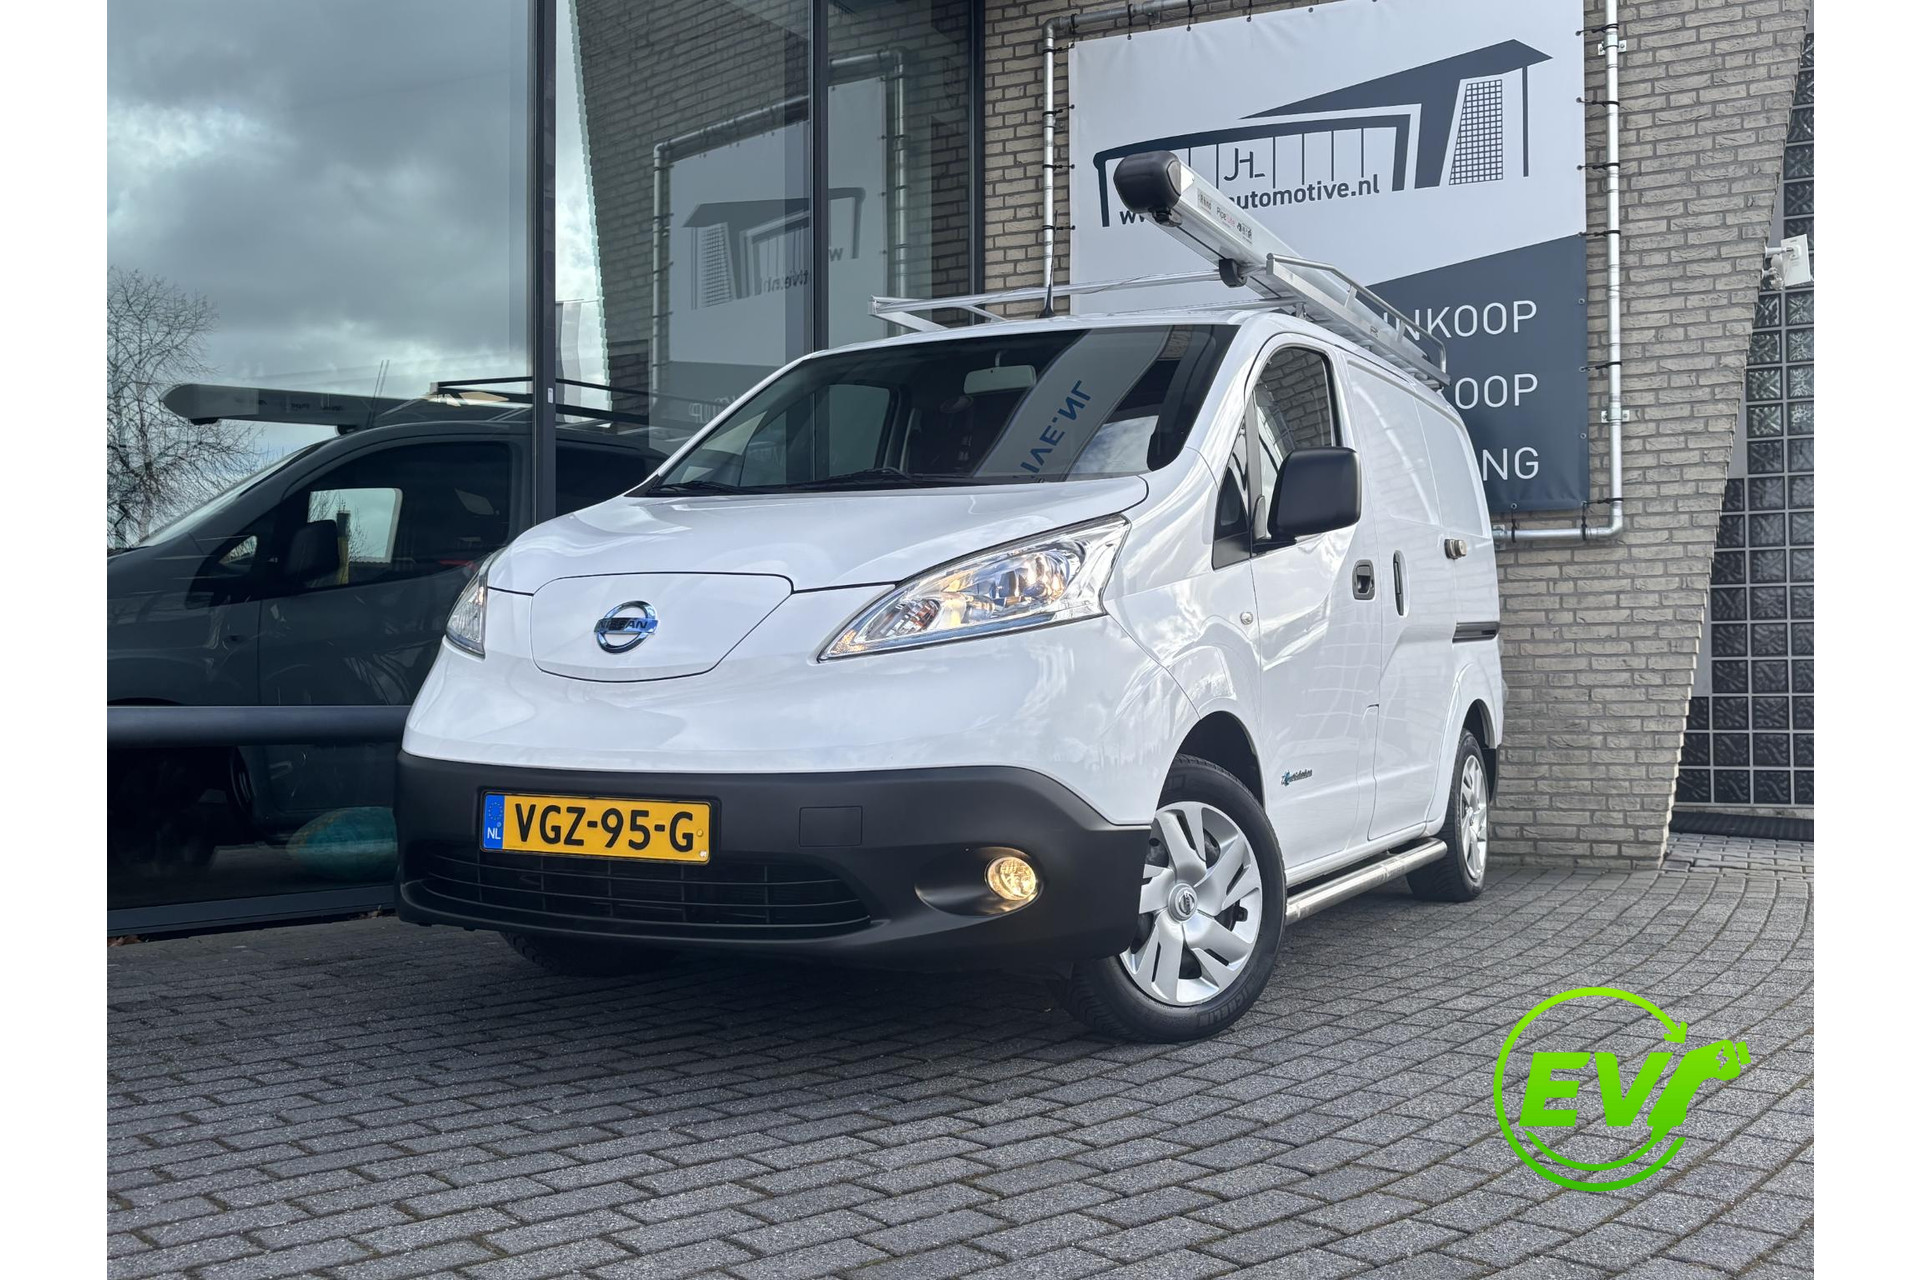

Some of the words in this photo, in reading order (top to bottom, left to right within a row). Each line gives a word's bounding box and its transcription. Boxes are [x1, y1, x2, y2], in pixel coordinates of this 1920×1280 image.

[1455, 373, 1538, 410] OOP
[1482, 446, 1539, 481] NG
[487, 827, 501, 840] NL
[515, 803, 693, 852] VGZ-95-G
